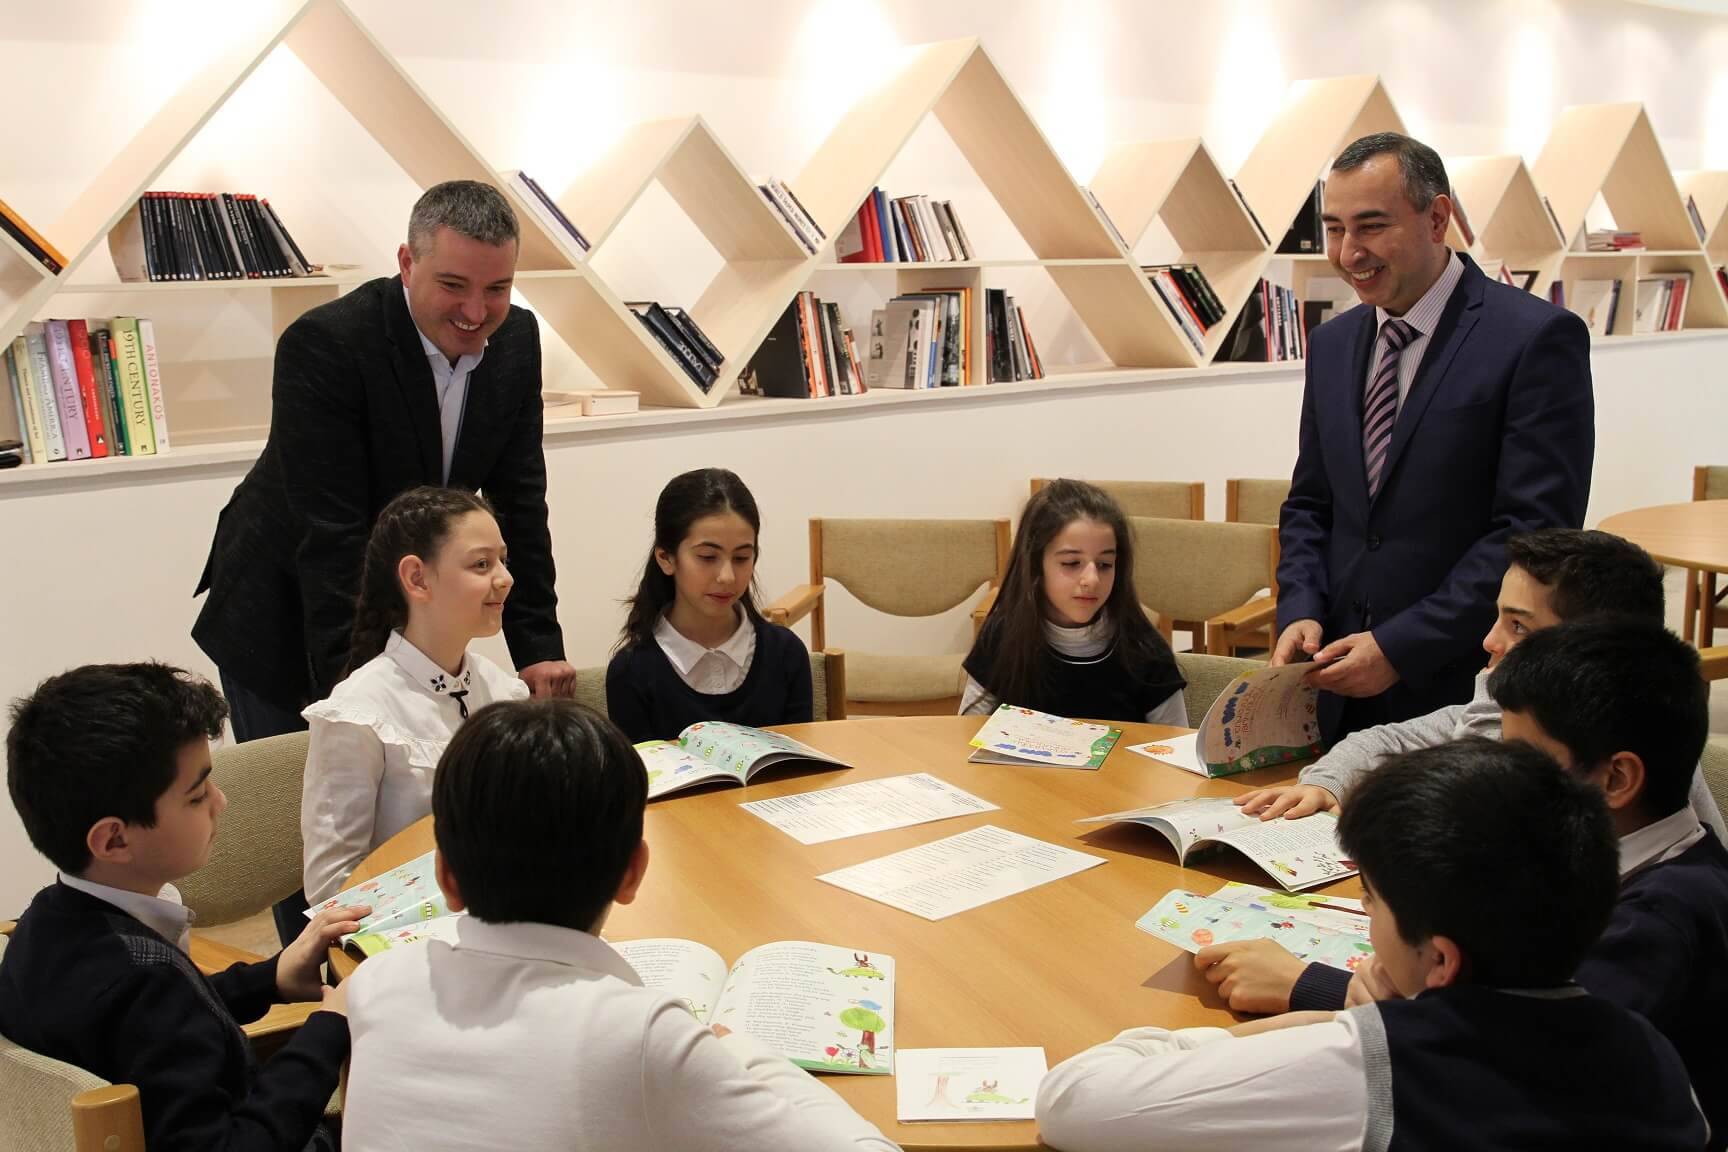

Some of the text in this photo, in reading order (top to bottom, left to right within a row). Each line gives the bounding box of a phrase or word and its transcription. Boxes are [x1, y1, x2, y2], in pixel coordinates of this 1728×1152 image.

[122, 329, 147, 427] 19TH CENTURY
[145, 344, 164, 421] ANTONAKOS
